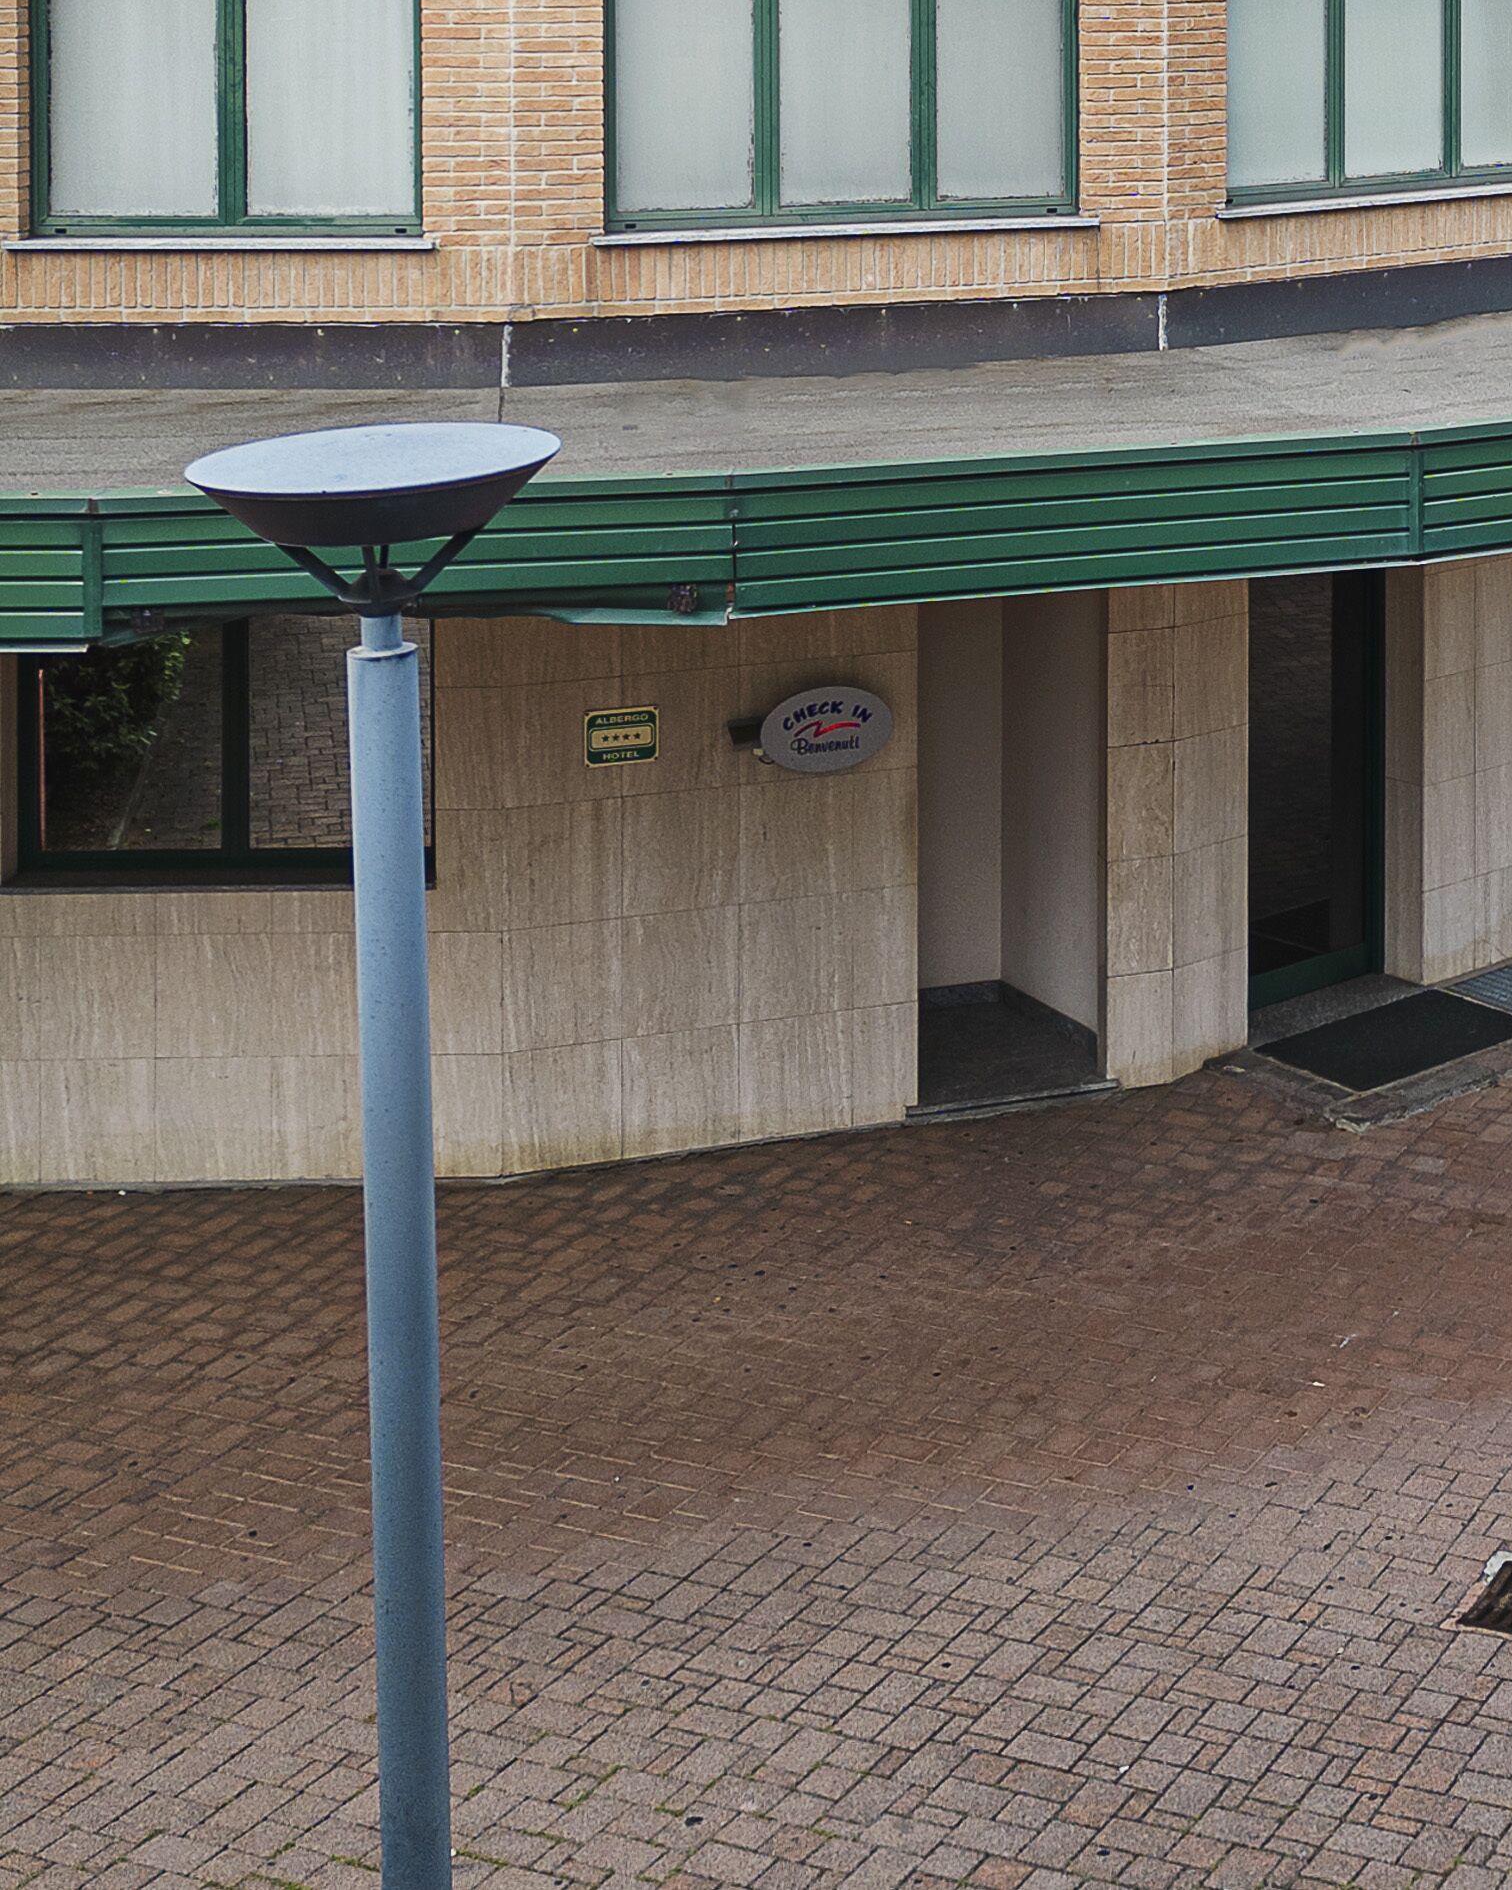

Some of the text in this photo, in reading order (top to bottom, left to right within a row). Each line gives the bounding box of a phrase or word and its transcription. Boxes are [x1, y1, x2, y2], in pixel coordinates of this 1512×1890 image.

[595, 713, 649, 725] ALBERGO
[782, 700, 873, 731] CHECK IN
[790, 735, 860, 756] Benvenuti
[602, 750, 640, 761] HOTEL
